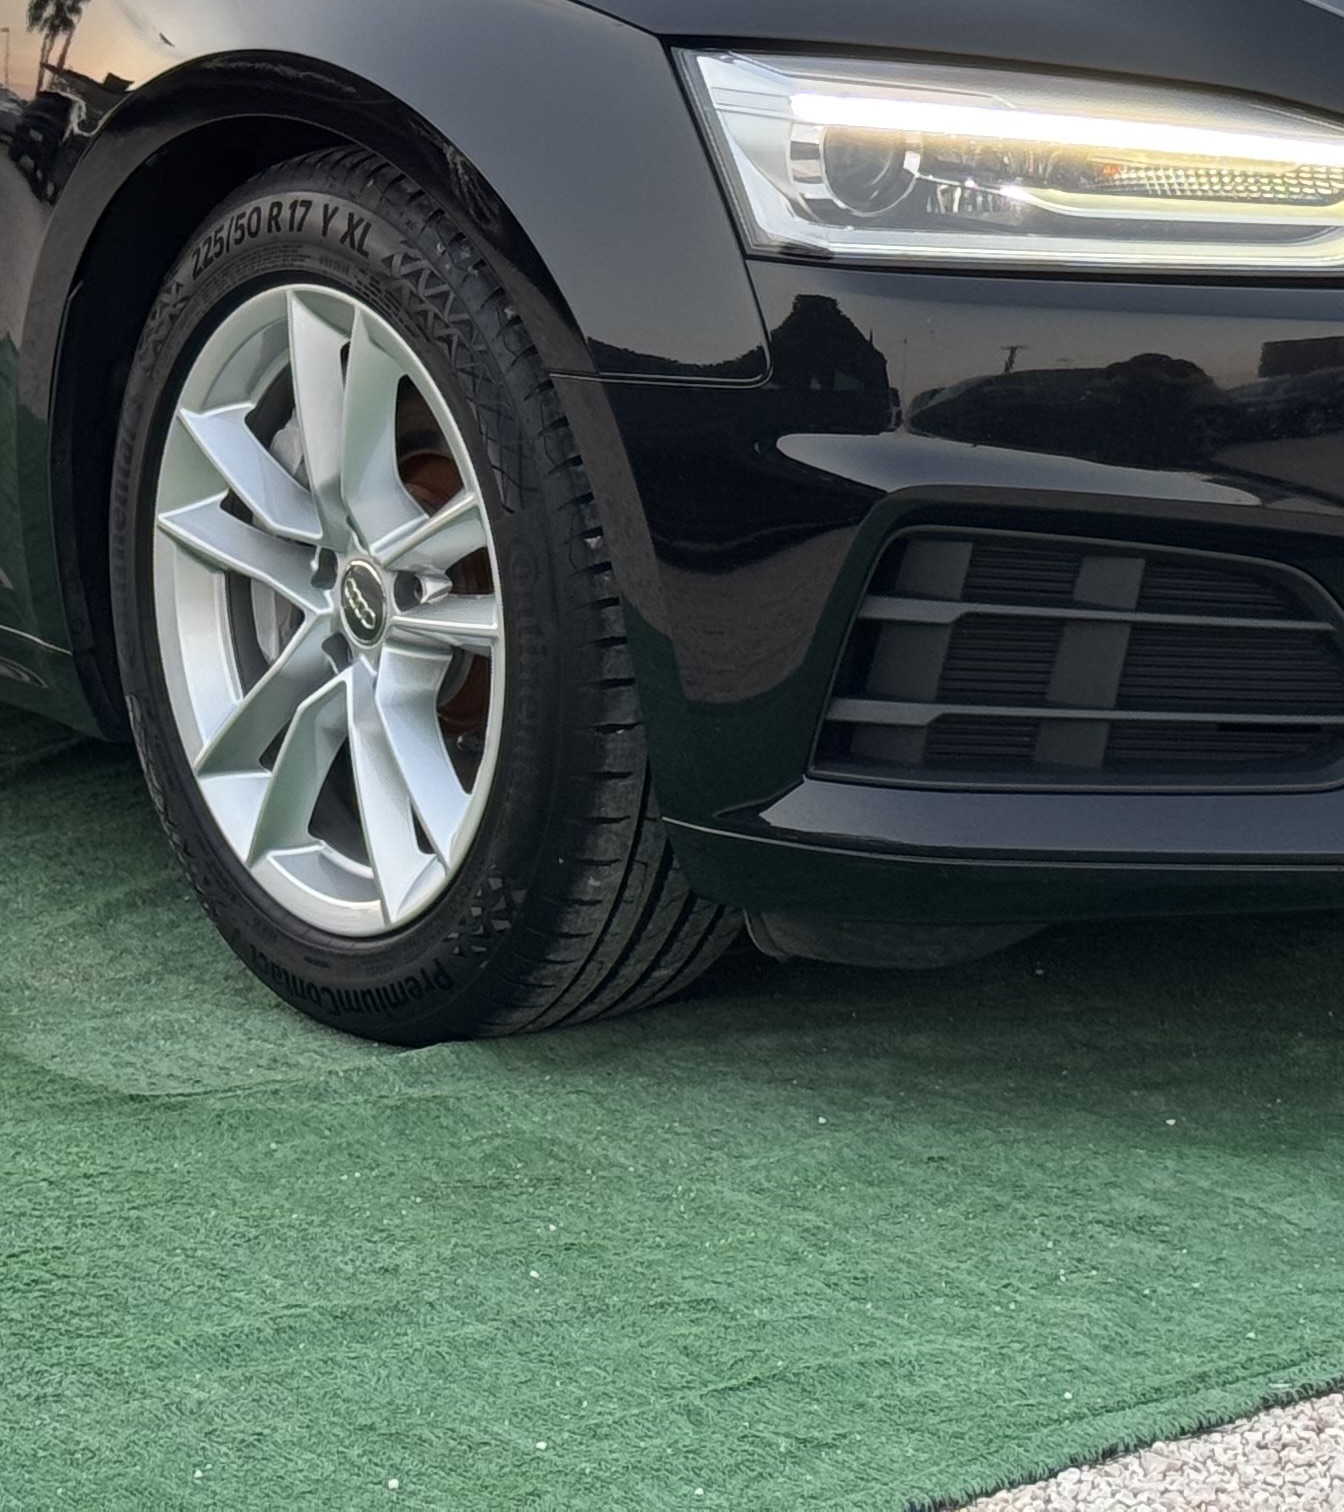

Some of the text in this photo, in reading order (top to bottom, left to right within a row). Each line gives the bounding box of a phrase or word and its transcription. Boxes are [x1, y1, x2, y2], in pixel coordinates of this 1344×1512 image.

[191, 206, 262, 281] 225/50
[267, 201, 283, 234] R
[288, 199, 313, 233] 17
[320, 203, 339, 238] Y
[340, 211, 373, 259] XL
